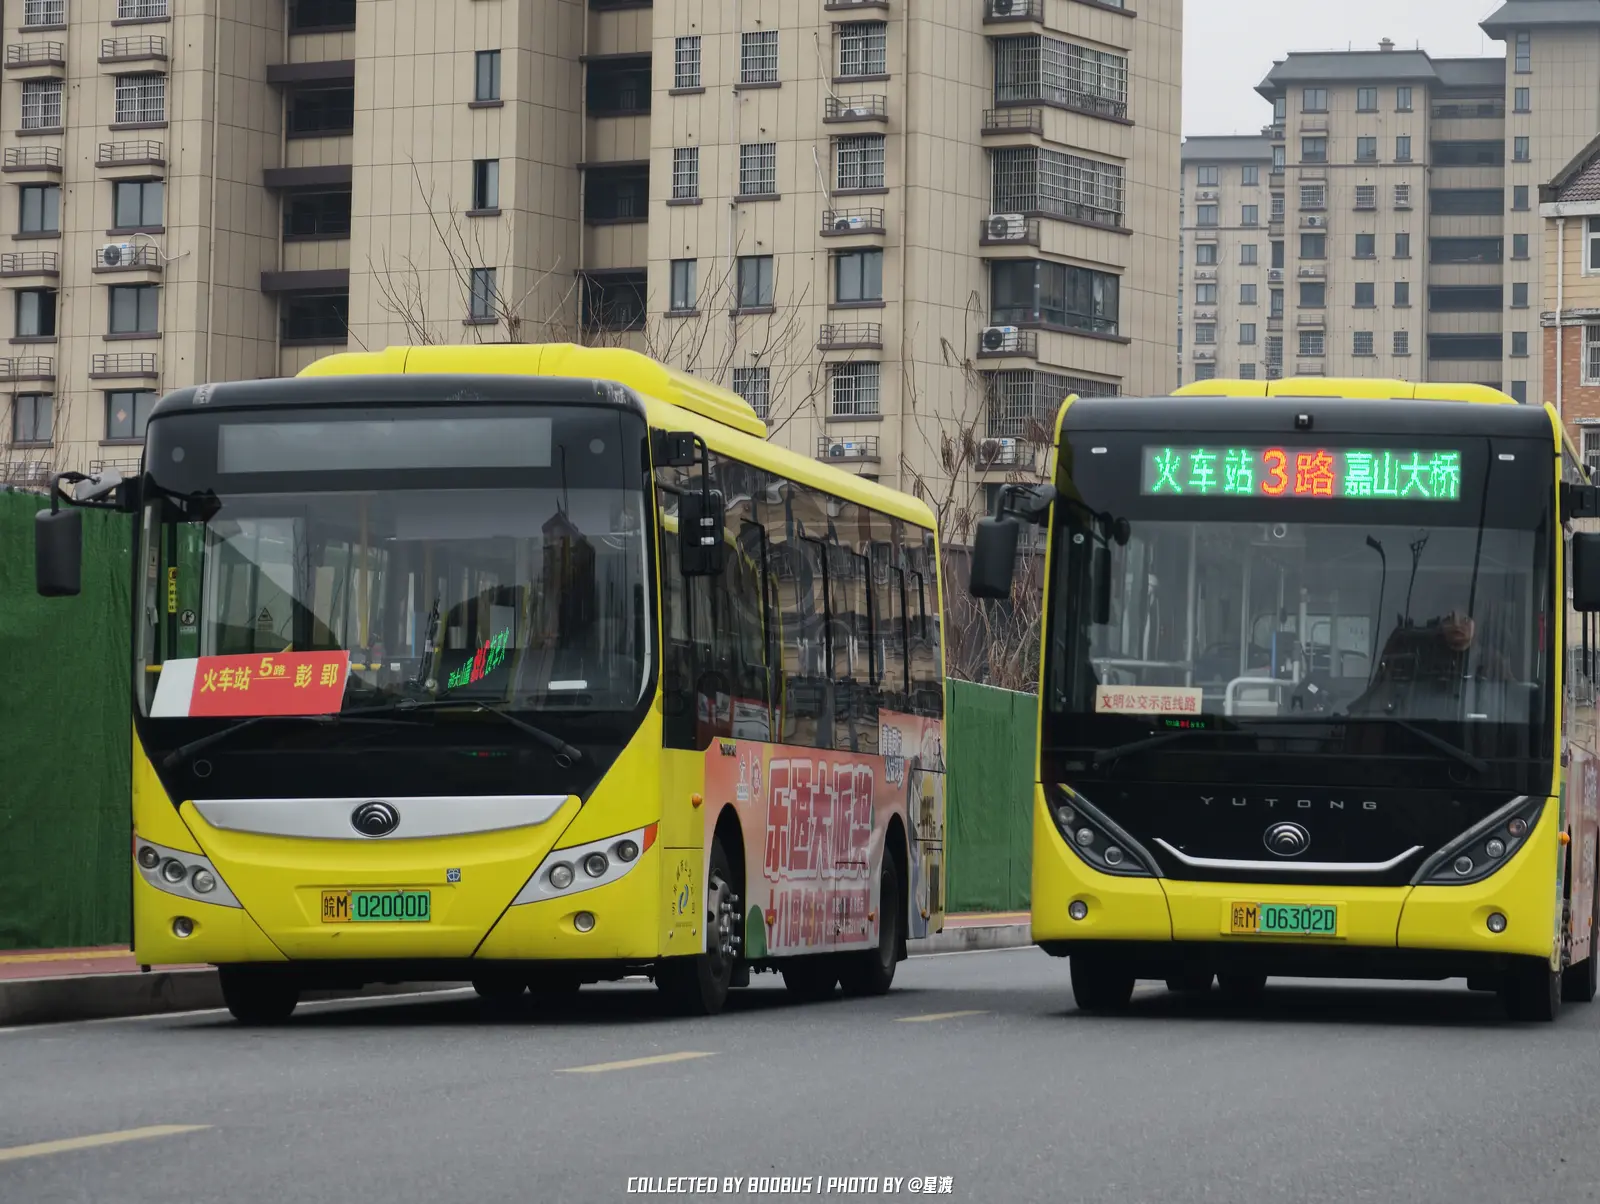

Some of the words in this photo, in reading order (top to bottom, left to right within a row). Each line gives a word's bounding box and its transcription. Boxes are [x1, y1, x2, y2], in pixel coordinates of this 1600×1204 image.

[1152, 448, 1253, 493] 火车站
[1344, 451, 1459, 497] 嘉山大桥
[200, 666, 252, 693] 火车站
[1101, 692, 1197, 712] 文明公交示范线路
[1200, 796, 1377, 810] YUTONG
